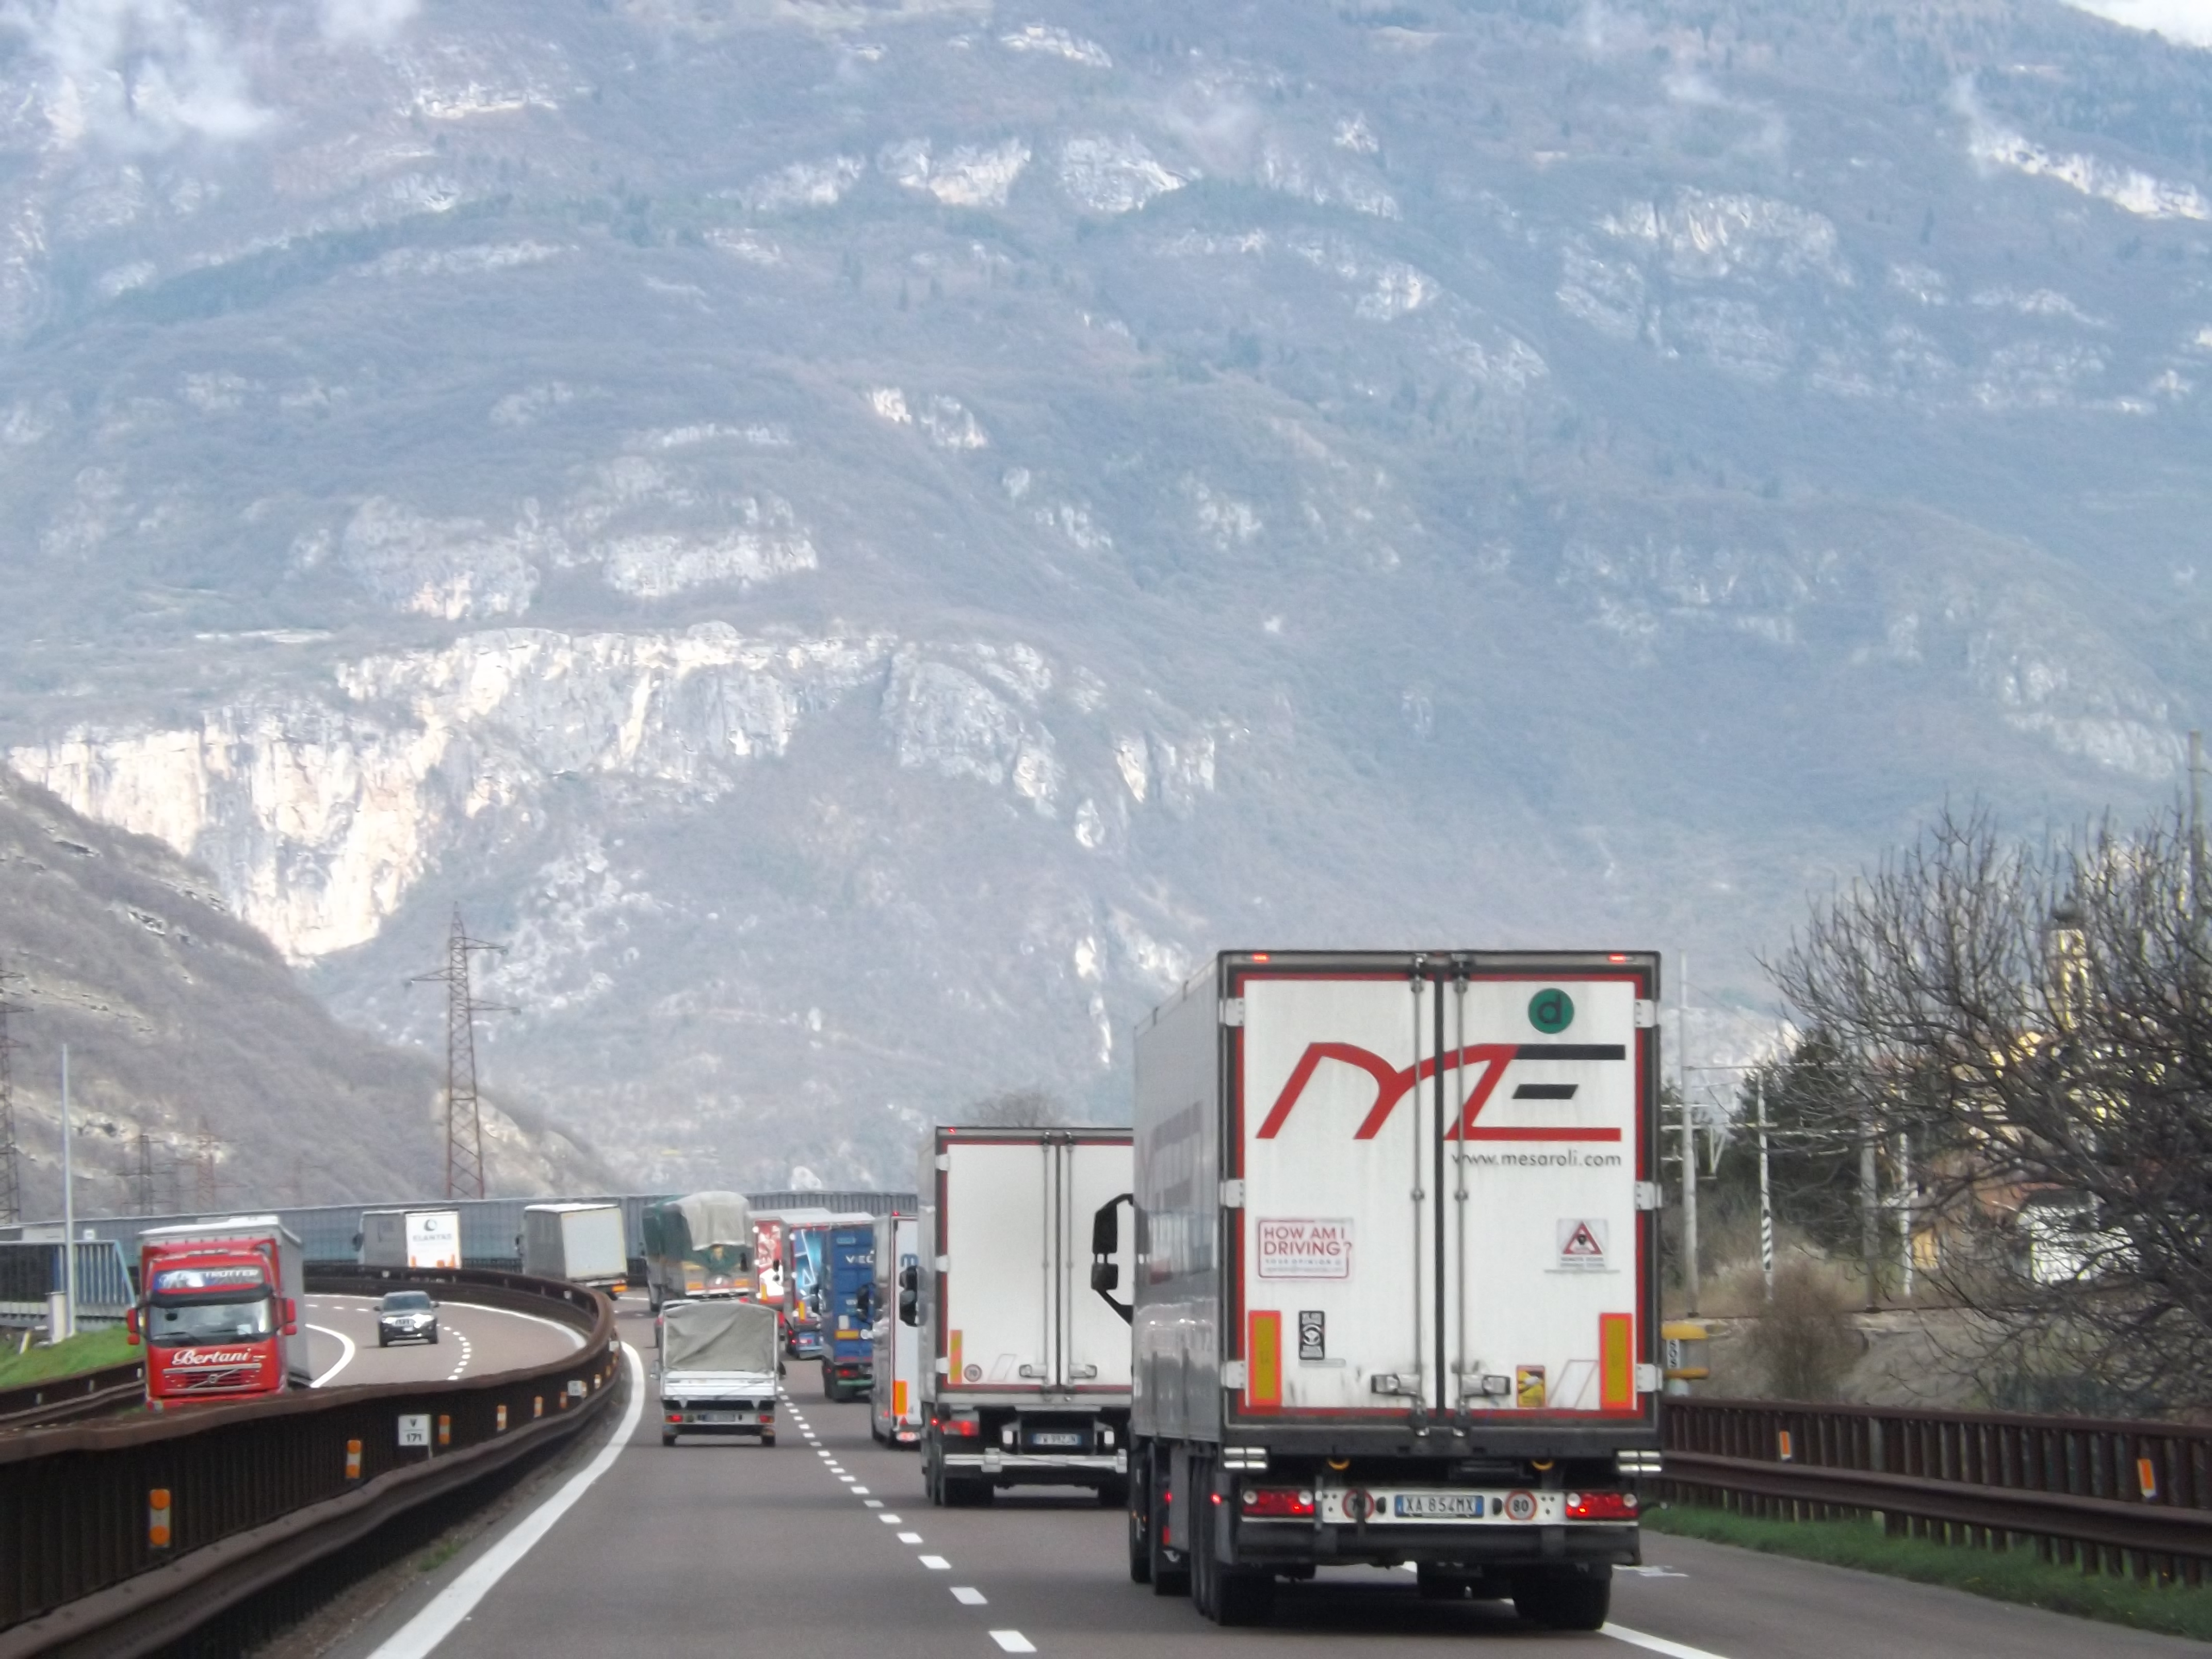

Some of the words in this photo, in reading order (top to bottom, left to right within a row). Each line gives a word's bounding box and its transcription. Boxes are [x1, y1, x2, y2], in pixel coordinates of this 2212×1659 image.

[1451, 1149, 1622, 1166] www.mesaroli.com
[1264, 1227, 1304, 1239] HOW
[1311, 1227, 1336, 1239] AM
[1341, 1227, 1344, 1239] I
[1264, 1241, 1353, 1256] DRIVING?
[172, 1347, 251, 1365] Bertani
[1512, 1499, 1529, 1512] 80
